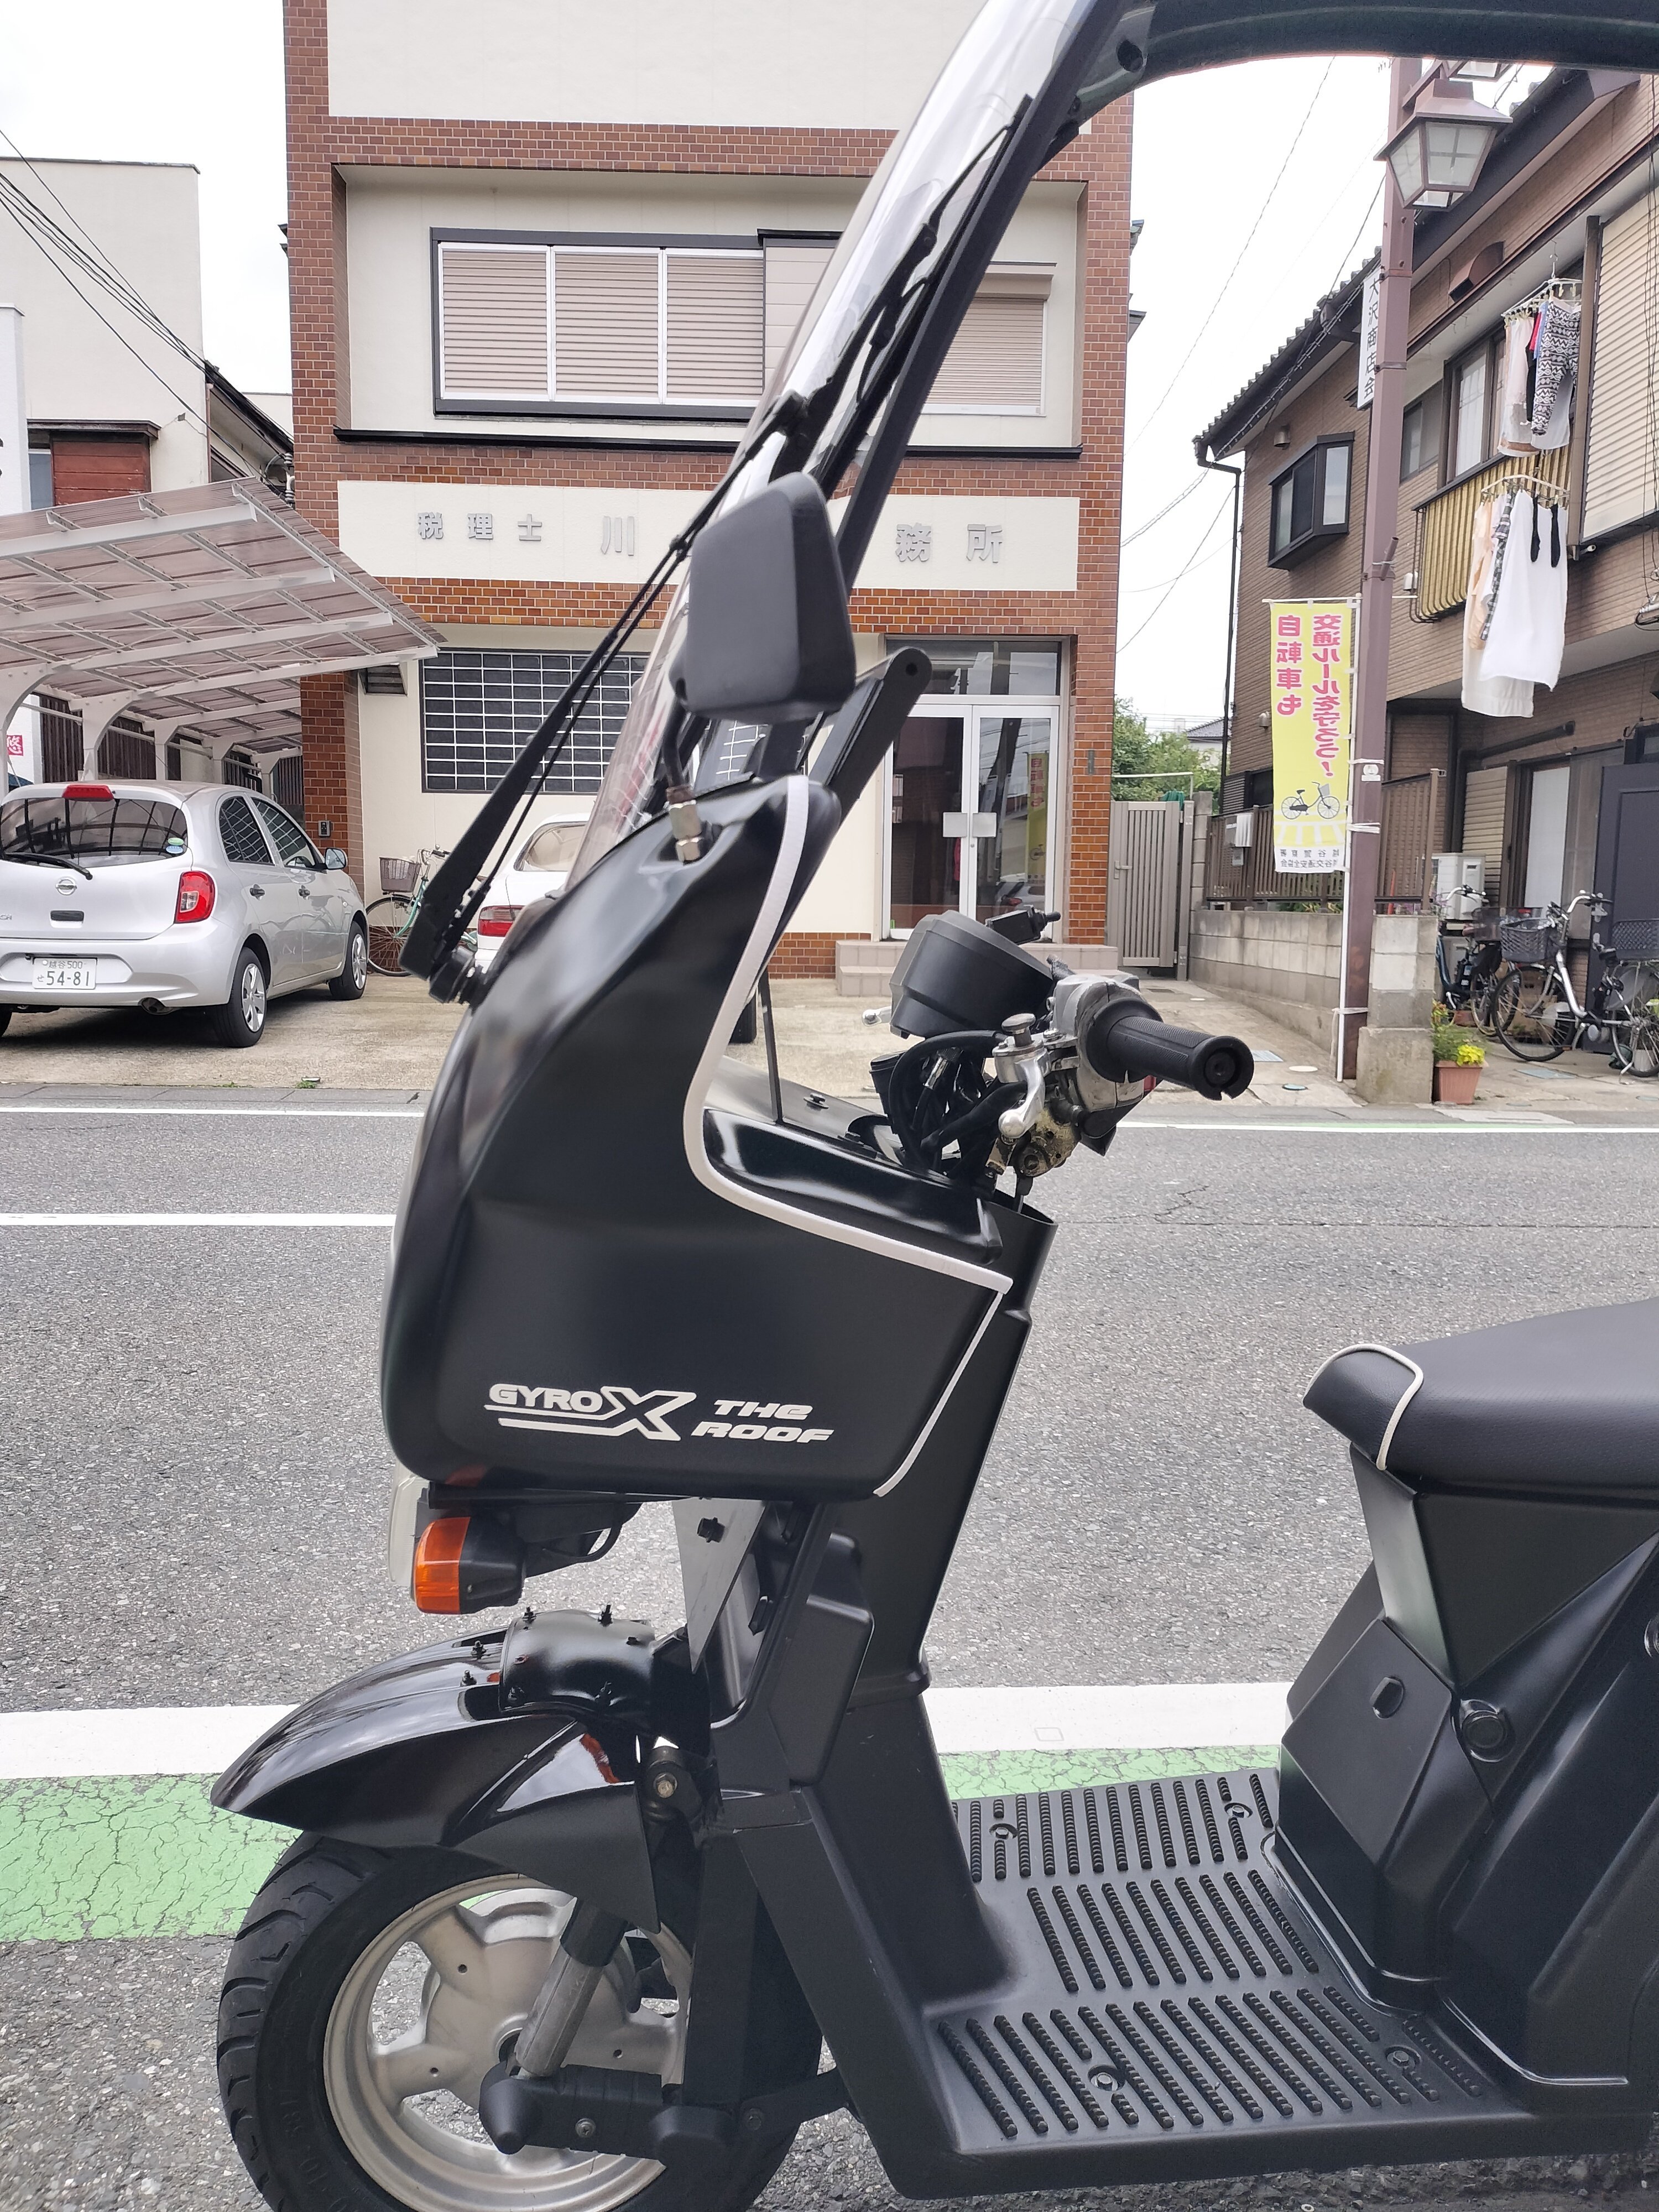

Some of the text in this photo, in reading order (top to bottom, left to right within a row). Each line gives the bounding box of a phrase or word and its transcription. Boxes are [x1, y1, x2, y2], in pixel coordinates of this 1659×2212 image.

[418, 512, 1003, 563] 税理士 川 務所
[46, 971, 89, 986] 54-81
[691, 1421, 834, 1443] ROOF
